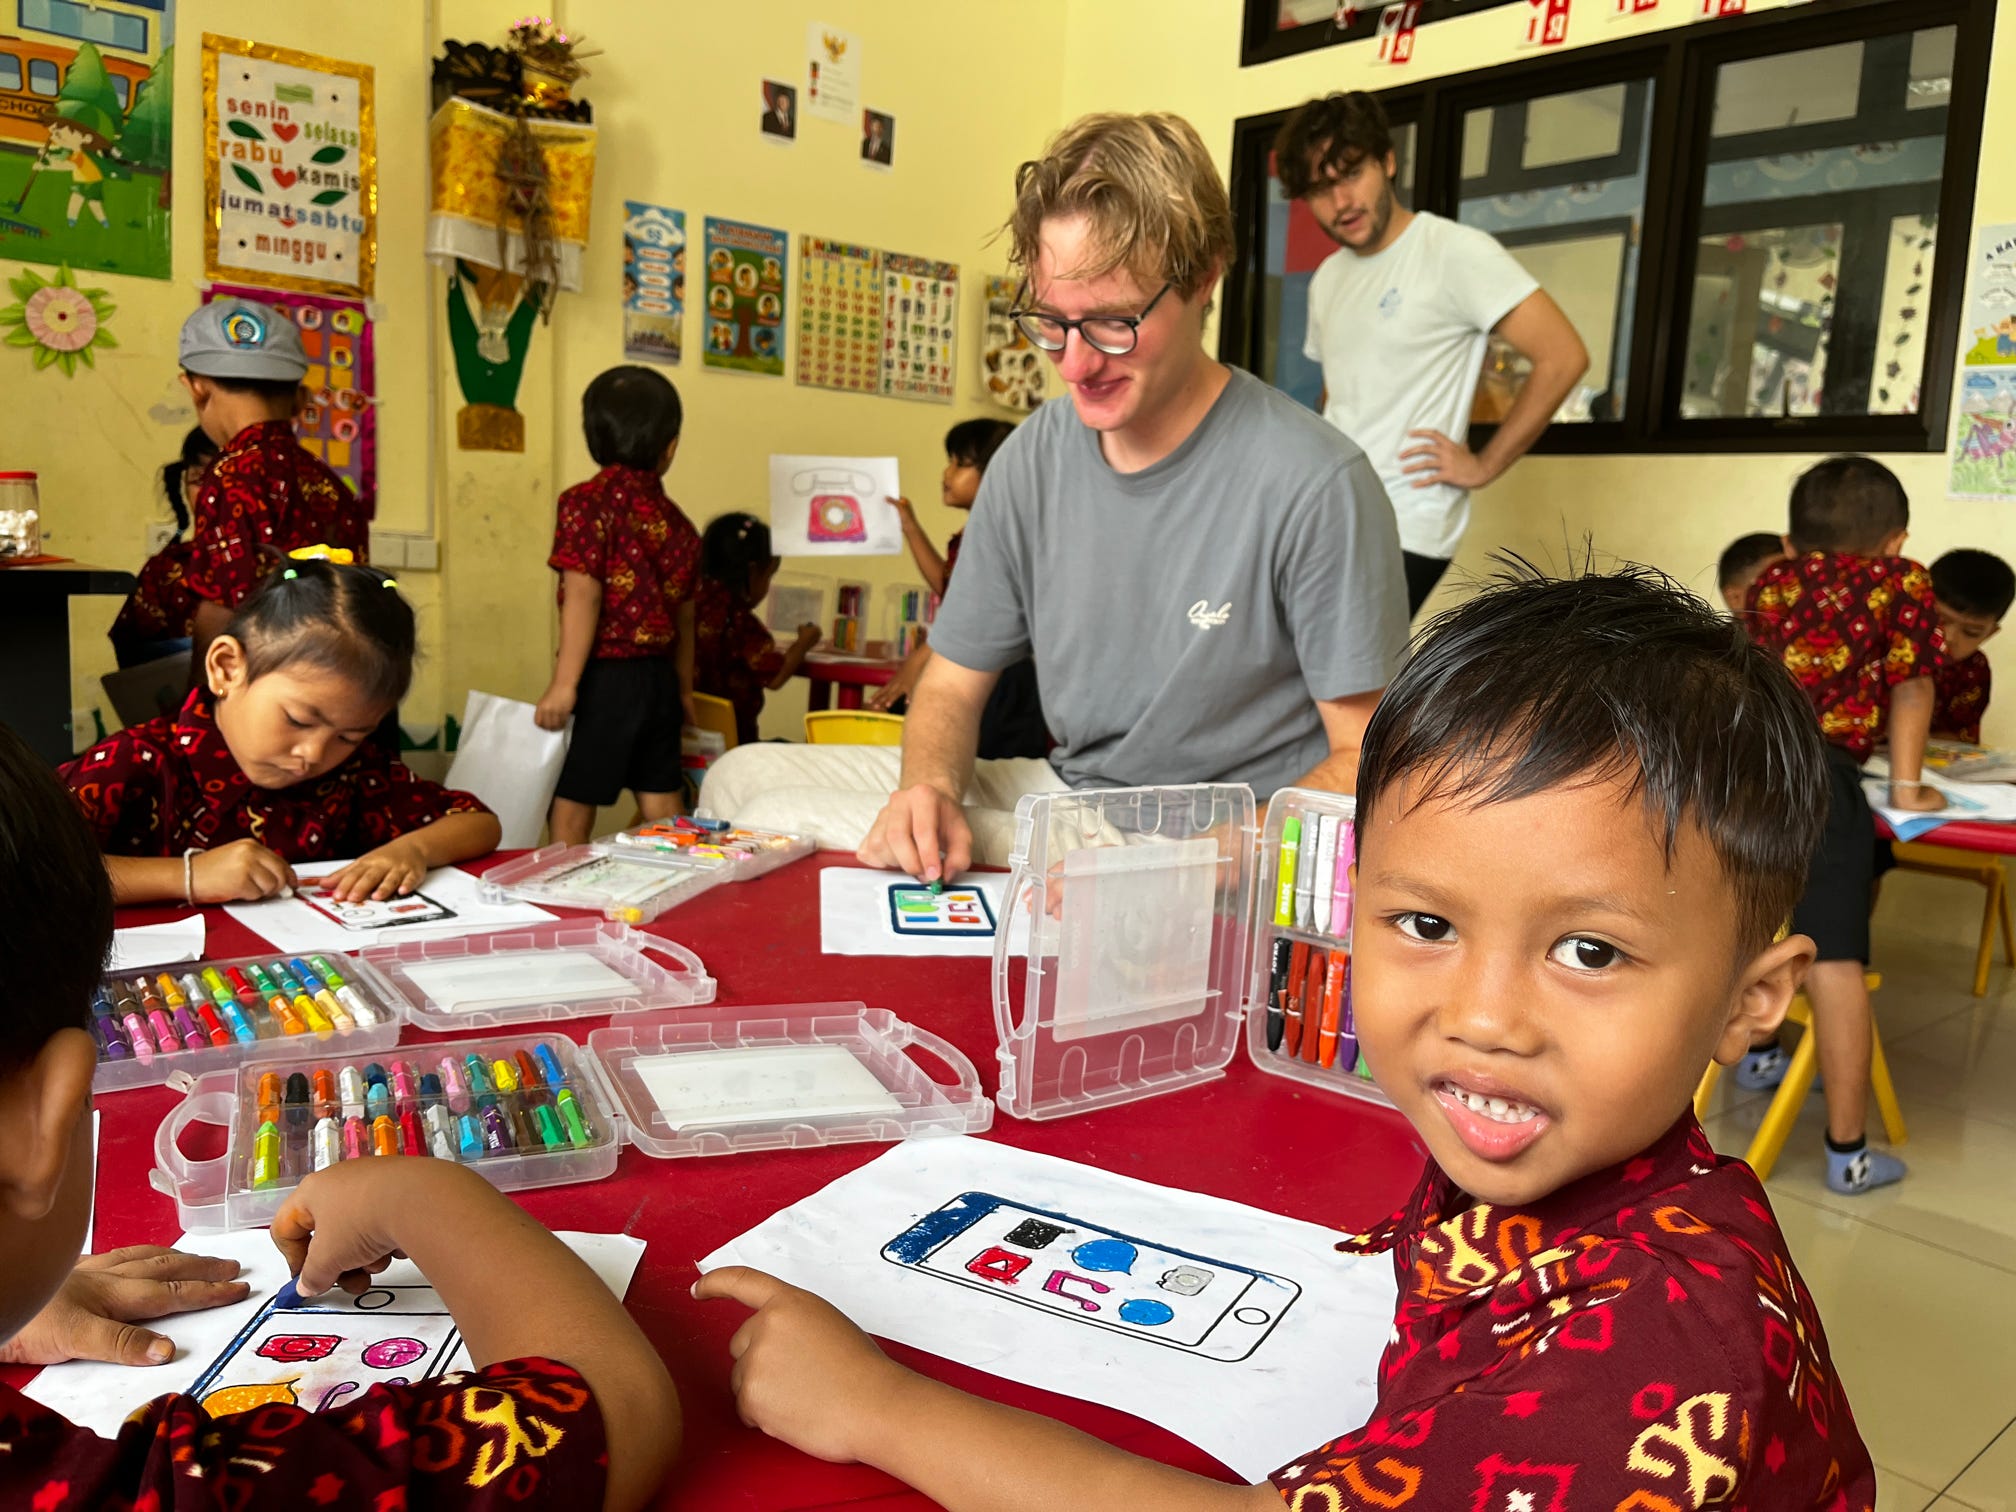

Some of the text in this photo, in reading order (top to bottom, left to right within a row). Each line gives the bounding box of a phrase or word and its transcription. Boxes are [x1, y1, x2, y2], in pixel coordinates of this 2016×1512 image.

[226, 97, 289, 121] senin
[219, 140, 283, 165] rabu
[297, 163, 361, 191] kamis
[220, 189, 364, 234] jumat sabtu
[255, 233, 327, 264] minggu
